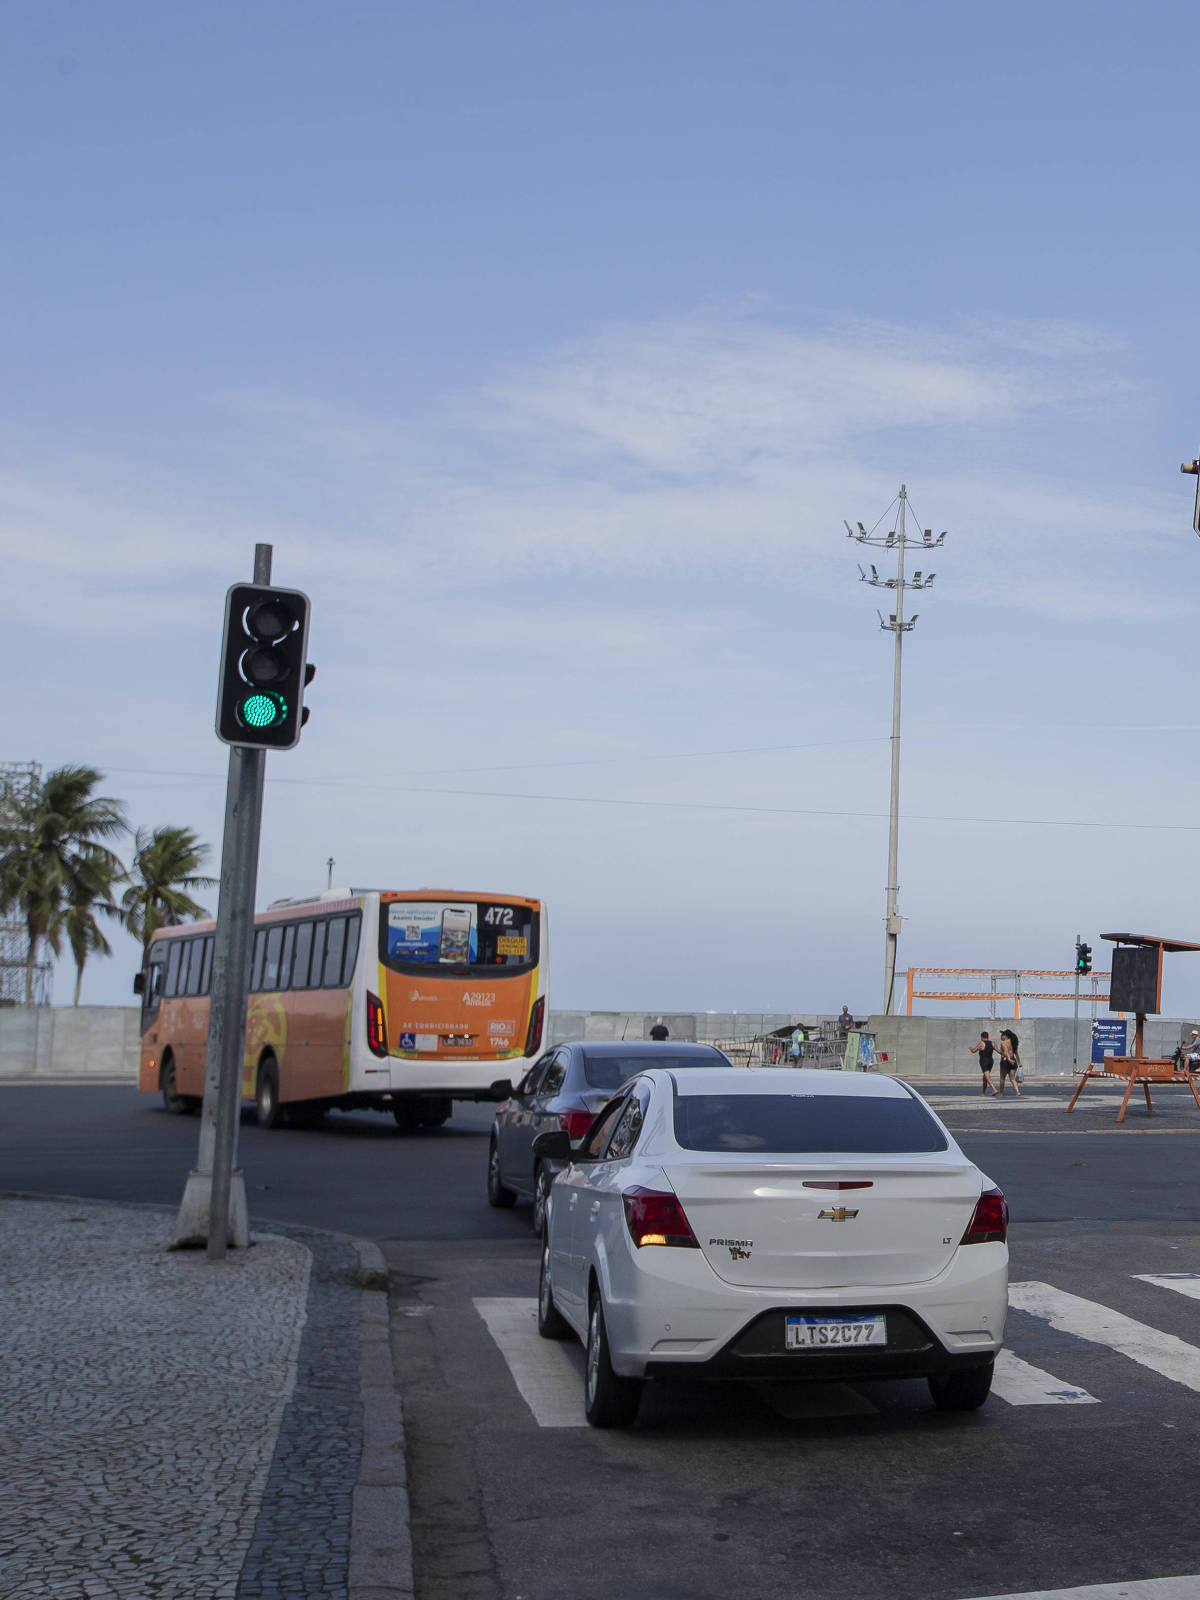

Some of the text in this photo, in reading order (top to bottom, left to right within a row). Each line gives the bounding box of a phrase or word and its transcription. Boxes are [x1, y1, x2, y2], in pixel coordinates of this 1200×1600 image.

[485, 907, 514, 926] 472
[490, 1037, 510, 1048] 1746
[709, 1238, 753, 1247] PRISMA
[795, 1324, 875, 1345] LTS2C77
